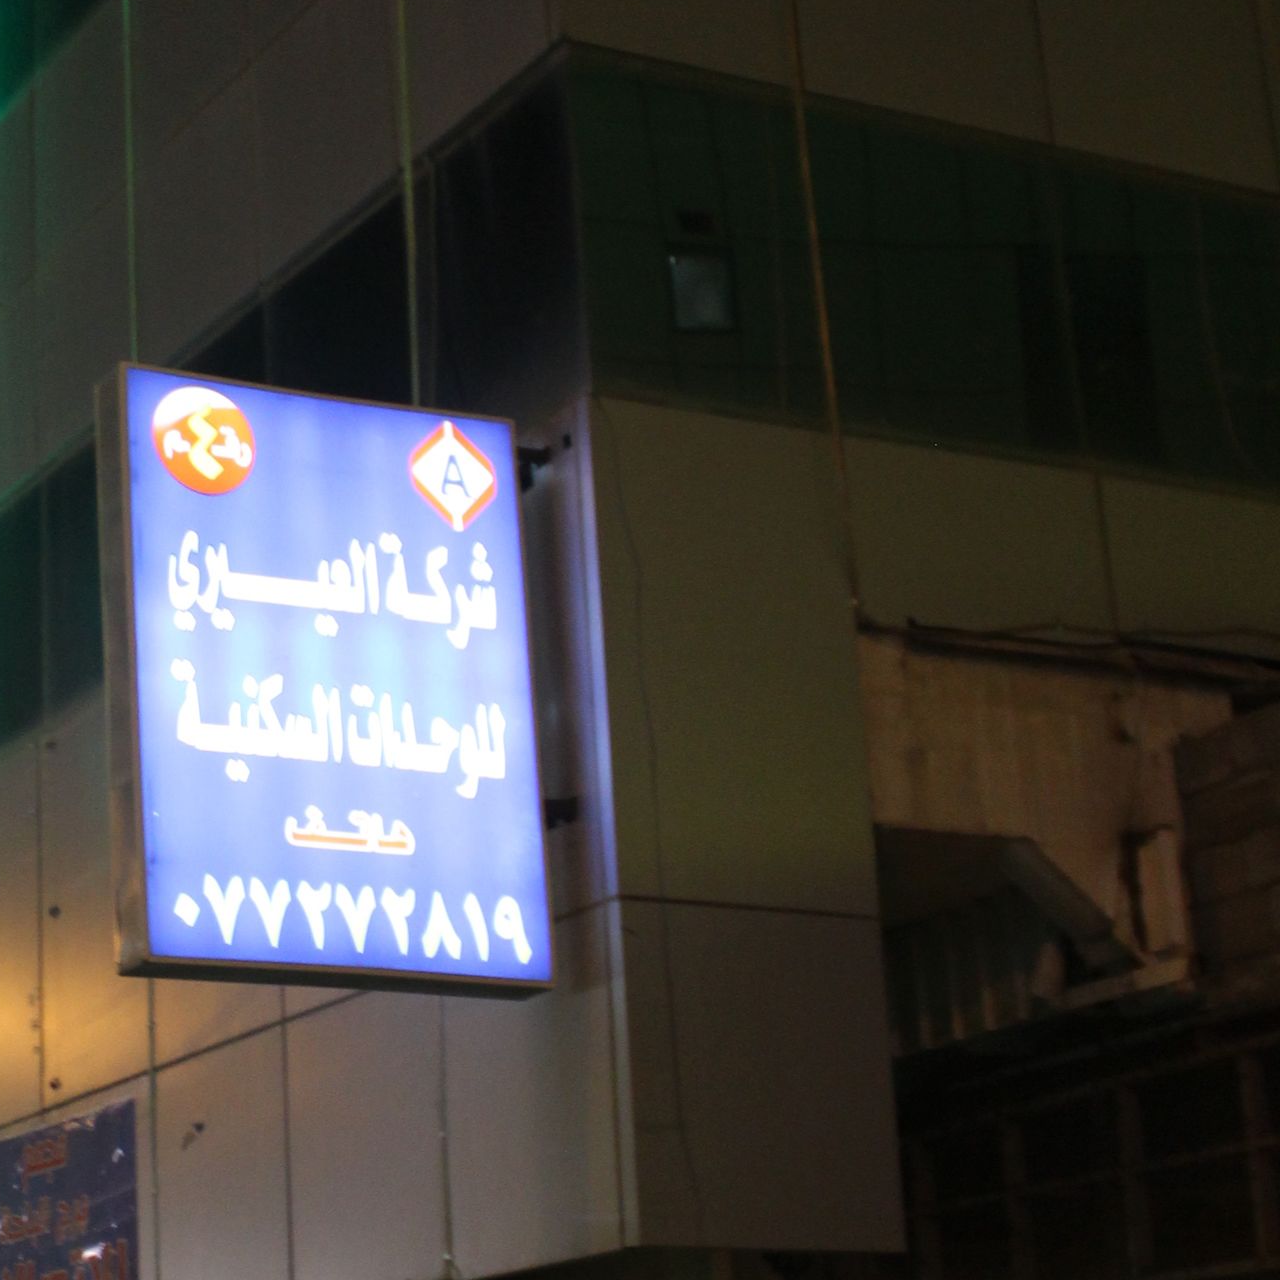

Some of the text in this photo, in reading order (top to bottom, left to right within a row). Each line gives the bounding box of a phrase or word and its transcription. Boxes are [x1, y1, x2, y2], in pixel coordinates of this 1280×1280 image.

[441, 454, 471, 499] A
[379, 532, 497, 649] شركة
[170, 657, 506, 800] للوحدات السكنية
[284, 805, 416, 856] هاتف
